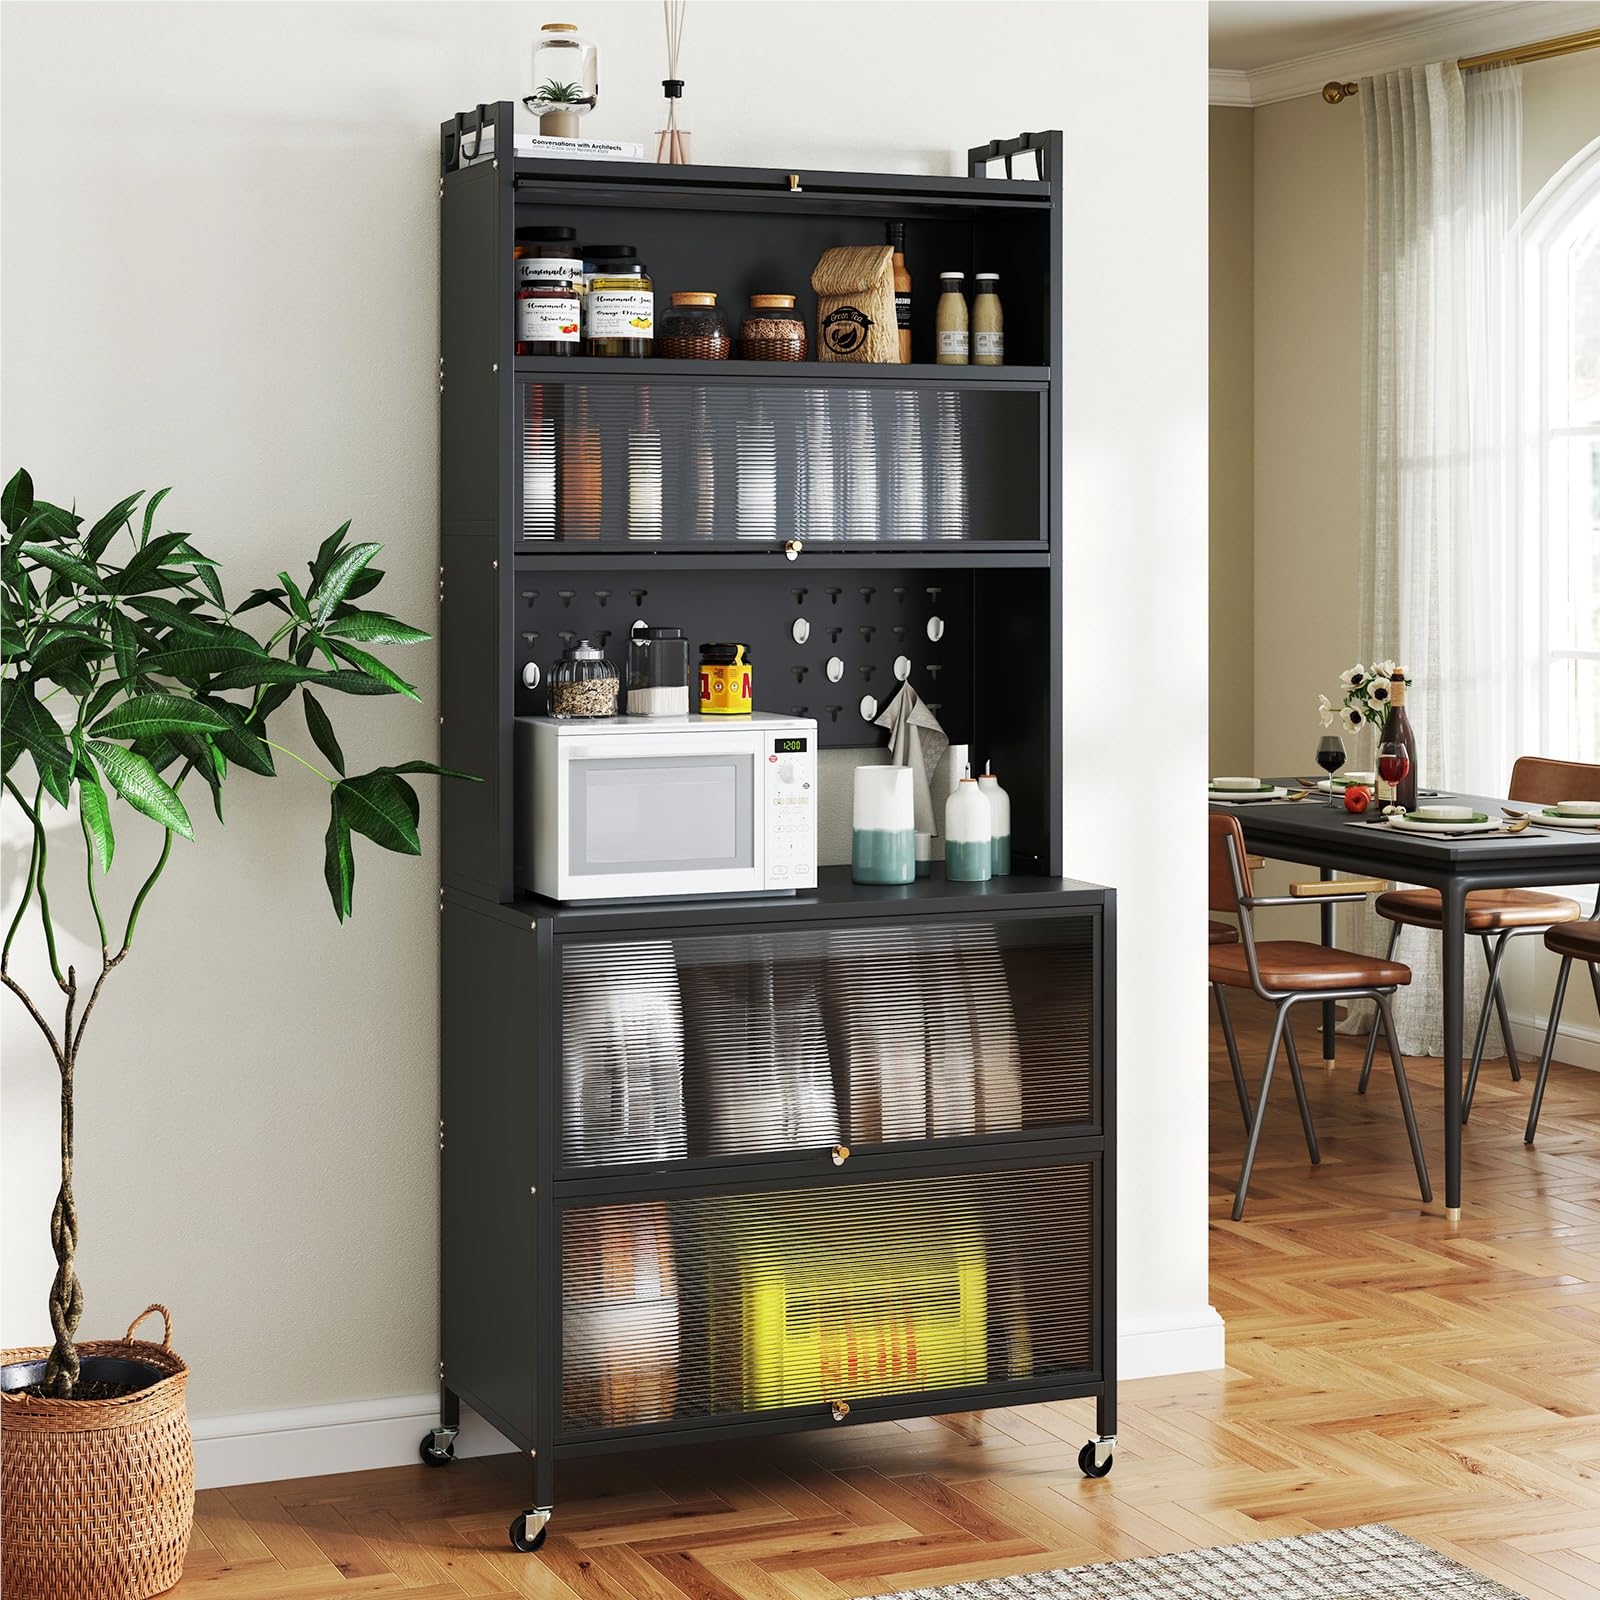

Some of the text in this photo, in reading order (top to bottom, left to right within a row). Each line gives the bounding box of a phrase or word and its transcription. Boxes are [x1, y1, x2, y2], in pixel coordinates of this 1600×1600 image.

[531, 138, 576, 148] Conversations
[591, 143, 622, 151] Architects
[520, 265, 567, 276] Homemade
[597, 295, 636, 303] Homemade
[830, 311, 863, 323] Green Tea
[783, 740, 801, 750] 12:00
